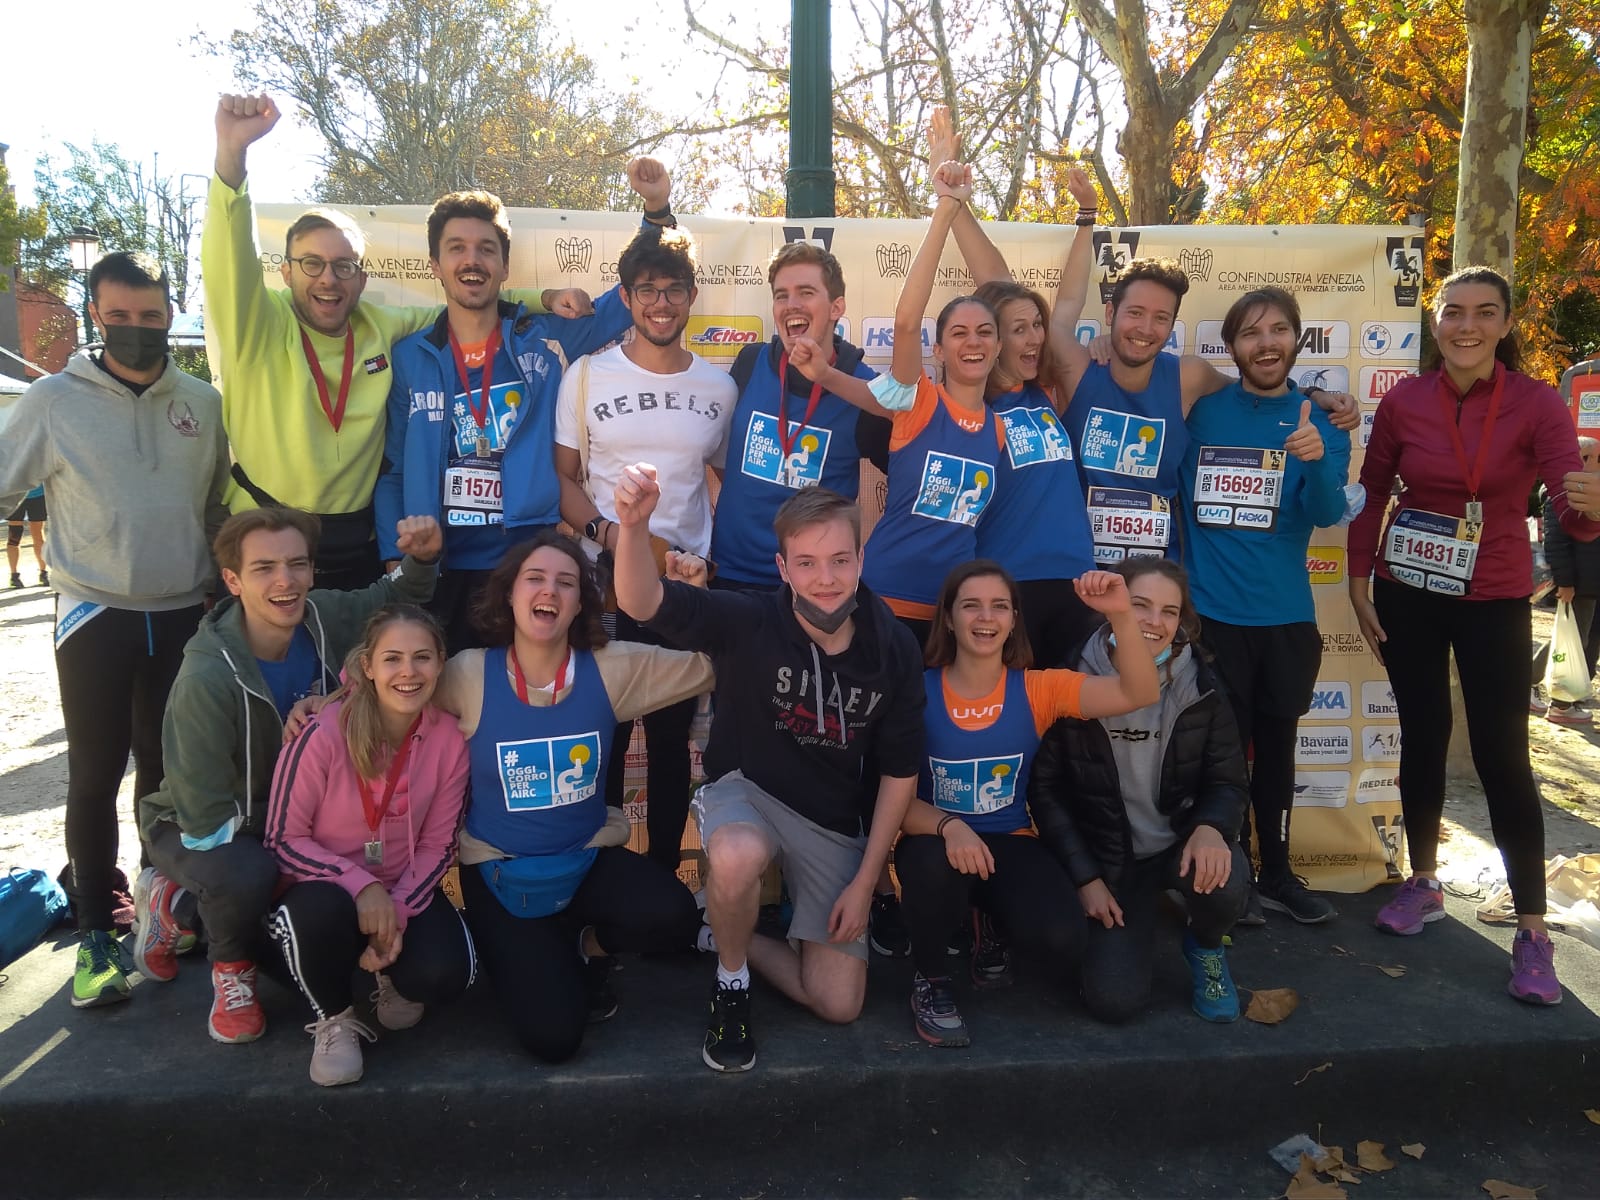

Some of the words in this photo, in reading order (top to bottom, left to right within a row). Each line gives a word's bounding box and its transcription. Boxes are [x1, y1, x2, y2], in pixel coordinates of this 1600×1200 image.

[376, 258, 432, 270] VENEZIA
[406, 272, 436, 280] ROVIGO
[709, 264, 763, 277] VENEZIA
[696, 277, 726, 285] VENEZIA
[734, 278, 763, 286] ROVIGO
[1217, 271, 1313, 284] CONFINDUSTRIA
[1316, 273, 1365, 285] VENEZIA
[592, 391, 723, 421] REBELS
[461, 428, 478, 438] PER
[1010, 430, 1038, 441] CORRO
[1089, 428, 1112, 438] OGGI
[462, 437, 477, 445] AIR
[751, 434, 774, 446] OGGI
[1012, 438, 1029, 449] PER
[1087, 435, 1119, 447] CORRO
[750, 441, 780, 455] CORRO
[1015, 444, 1035, 456] AIRC
[1086, 442, 1102, 451] PER
[749, 448, 764, 459] PER
[1084, 449, 1106, 459] AIRC
[747, 455, 768, 467] AIRC
[1117, 463, 1156, 477] AIRC
[928, 475, 952, 486] OGGI
[1213, 474, 1264, 494] 15692
[924, 490, 940, 498] PER
[926, 483, 956, 494] CORRO
[921, 497, 943, 507] AIRC
[1237, 511, 1268, 523] HOKA
[1105, 515, 1154, 535] 15634
[1406, 537, 1455, 565] 14831
[1429, 578, 1461, 592] HOKA
[1321, 633, 1363, 645] ENEZIA
[1337, 645, 1364, 653] ROVIGO
[776, 666, 883, 717] SILEY
[1300, 736, 1348, 748] Bavaria
[507, 765, 536, 777] OGGI
[508, 772, 548, 783] CORRO
[510, 781, 530, 791] PER
[511, 788, 537, 799] AIRC
[555, 785, 594, 804] AIRC
[977, 799, 1012, 812] AIRC
[1310, 853, 1358, 863] VENEZIA
